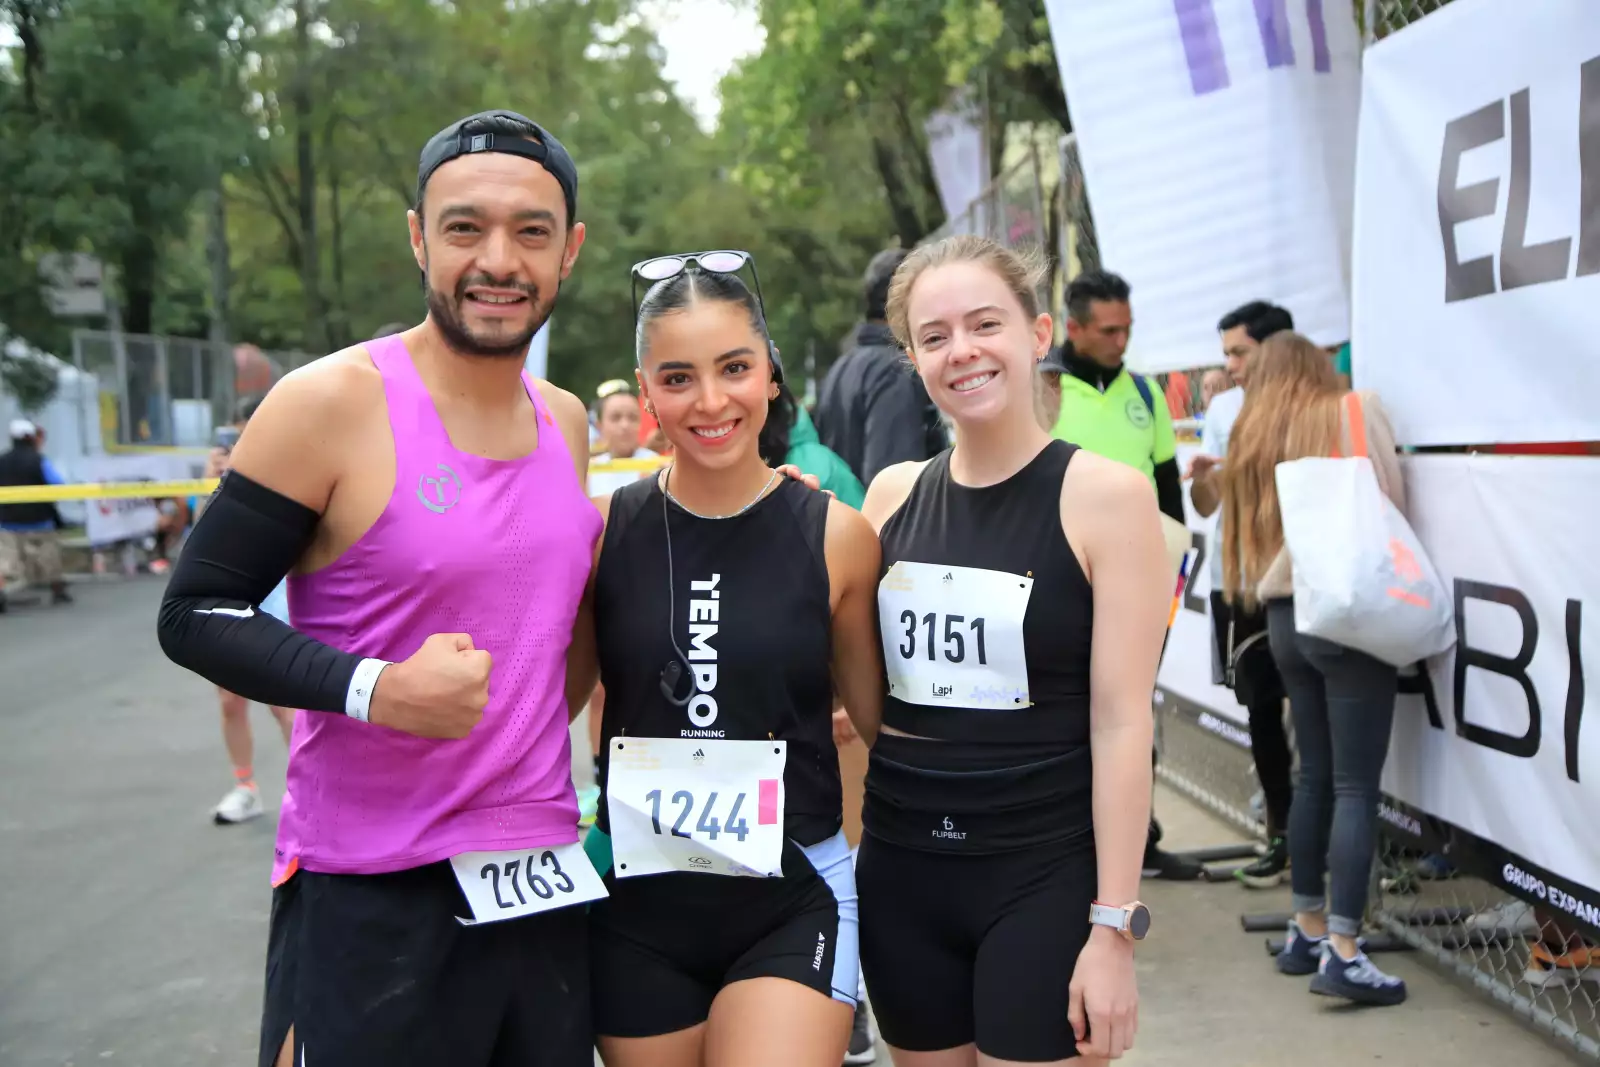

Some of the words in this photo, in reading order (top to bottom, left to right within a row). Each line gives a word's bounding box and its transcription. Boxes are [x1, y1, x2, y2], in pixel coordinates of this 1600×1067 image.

[688, 573, 720, 727] TEMPO
[899, 609, 987, 665] 3151
[680, 729, 725, 738] RUNNING
[645, 789, 750, 842] 1244
[932, 829, 967, 840] FLIPBELT
[480, 850, 575, 909] 2763
[1502, 862, 1547, 900] GRUPO
[812, 941, 825, 972] TECHFIT
